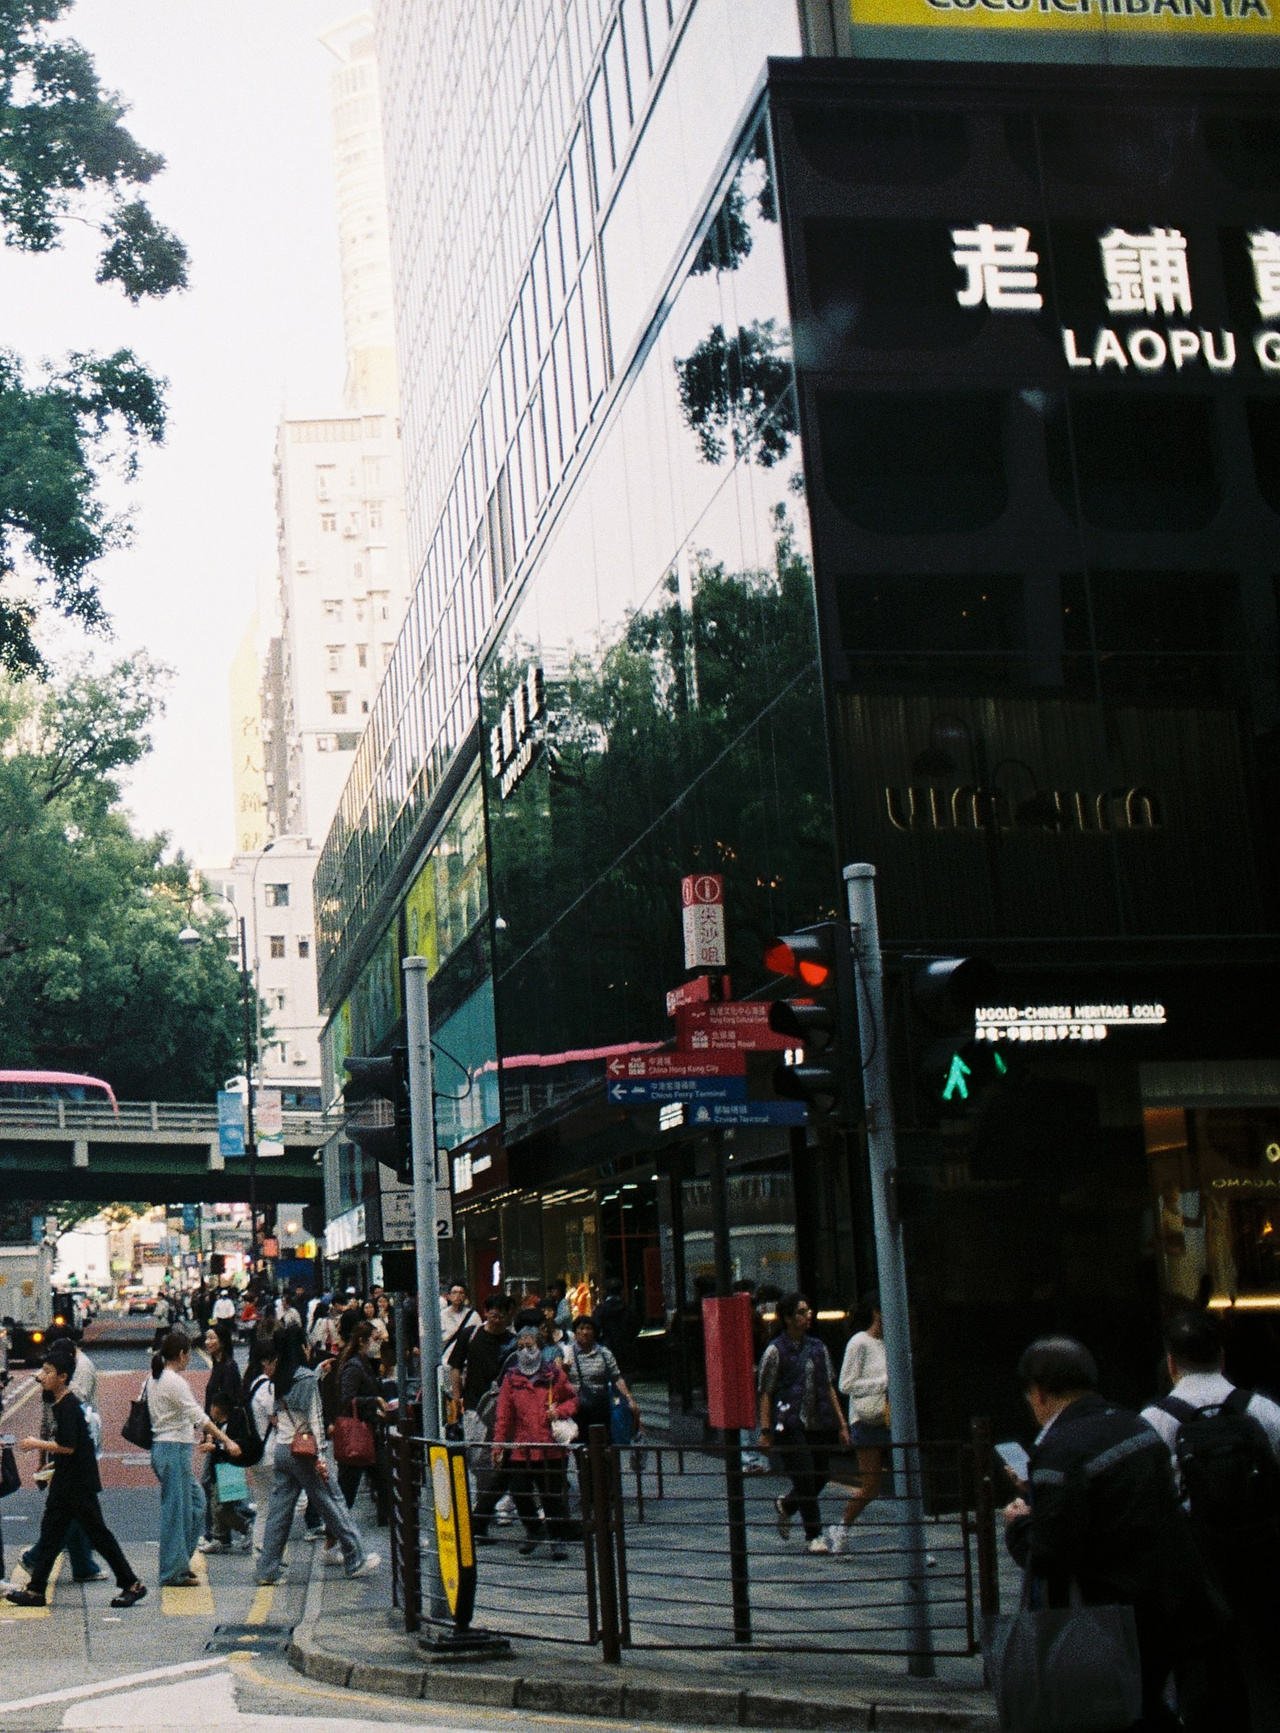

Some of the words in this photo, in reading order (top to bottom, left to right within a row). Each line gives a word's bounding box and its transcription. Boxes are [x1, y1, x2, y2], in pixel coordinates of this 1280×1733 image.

[1063, 327, 1236, 372] LAOPU
[700, 906, 720, 963] 尖沙咀
[1075, 1005, 1130, 1018] HERITAGE
[1132, 1003, 1166, 1018] GOLD
[712, 1040, 736, 1049] Peking
[737, 1040, 756, 1048] Road
[648, 1066, 669, 1074] China
[669, 1065, 686, 1075] Hong
[687, 1064, 705, 1075] Kong
[705, 1064, 719, 1074] City
[650, 1090, 673, 1099] China
[674, 1090, 693, 1099] Ferry
[694, 1089, 727, 1098] Terminal
[713, 1115, 738, 1123] Cruise
[739, 1114, 769, 1123] Terminal
